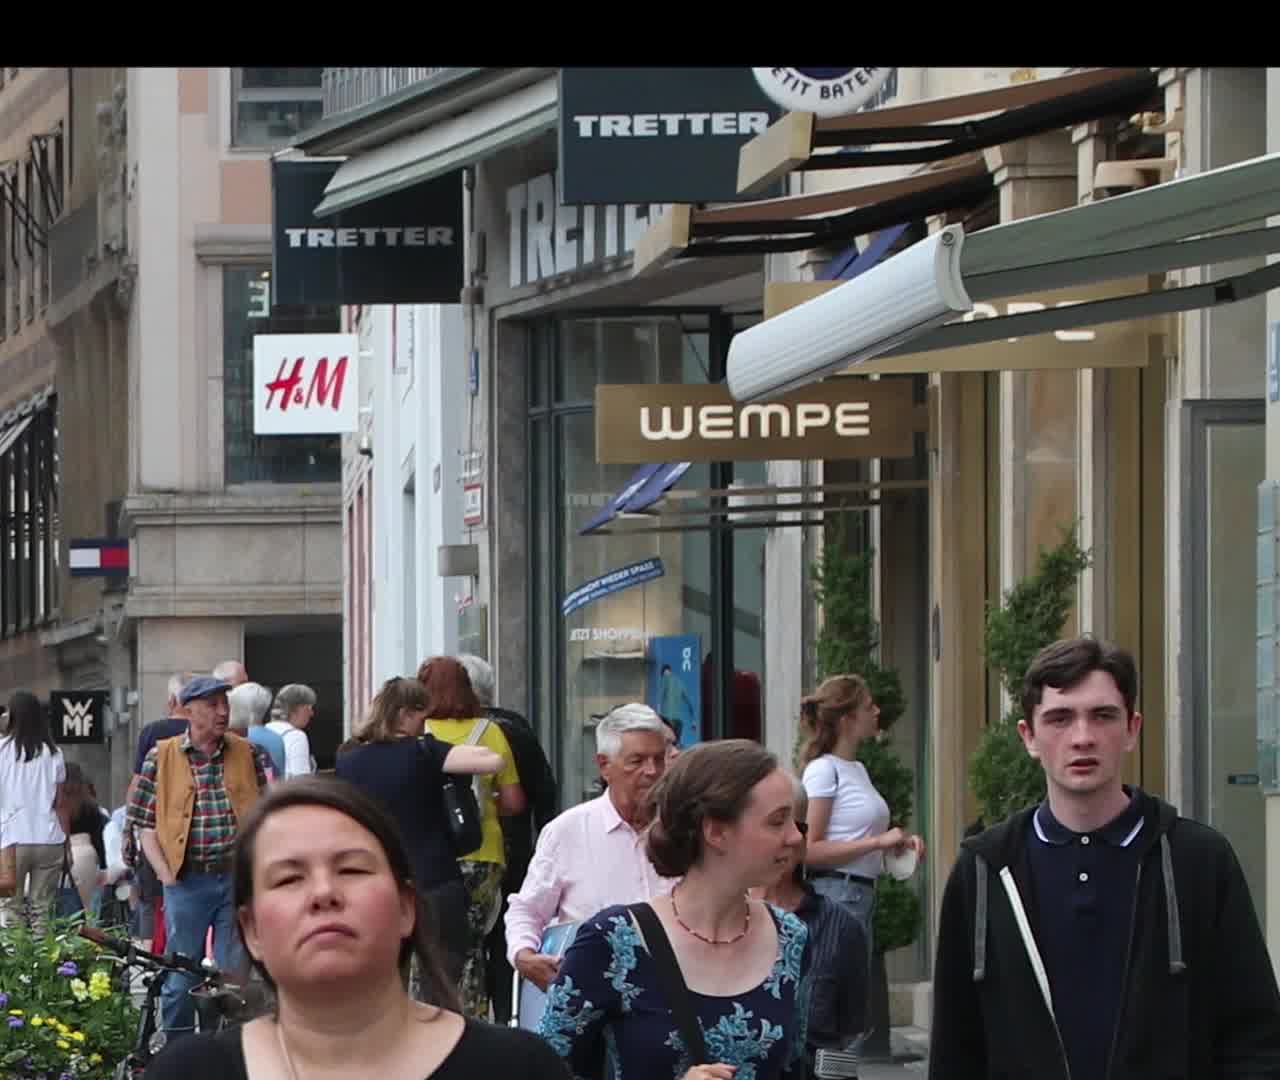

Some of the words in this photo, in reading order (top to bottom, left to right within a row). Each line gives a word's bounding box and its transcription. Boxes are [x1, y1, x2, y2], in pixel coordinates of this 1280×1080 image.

[574, 112, 769, 136] TRETTER
[285, 227, 454, 247] TRETTER
[264, 357, 348, 412] H&M
[640, 402, 870, 440] WEMPE
